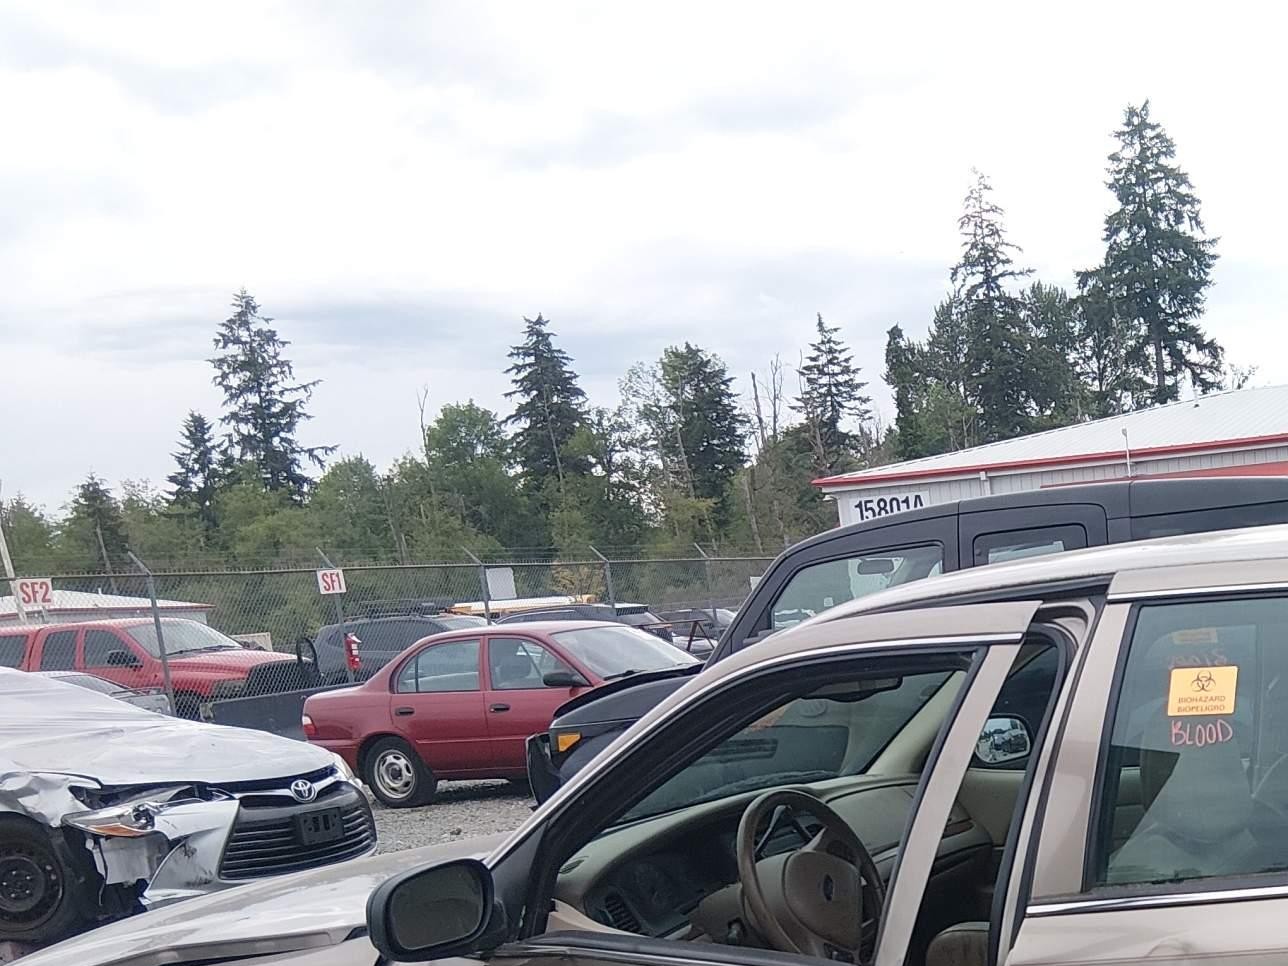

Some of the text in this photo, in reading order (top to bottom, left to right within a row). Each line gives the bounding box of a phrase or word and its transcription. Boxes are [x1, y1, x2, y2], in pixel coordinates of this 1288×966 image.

[854, 494, 923, 520] 15801A
[20, 581, 51, 604] SF2
[321, 572, 342, 592] SF1
[1178, 695, 1226, 704] BIOHAZARD
[1171, 719, 1233, 747] BLOOD
